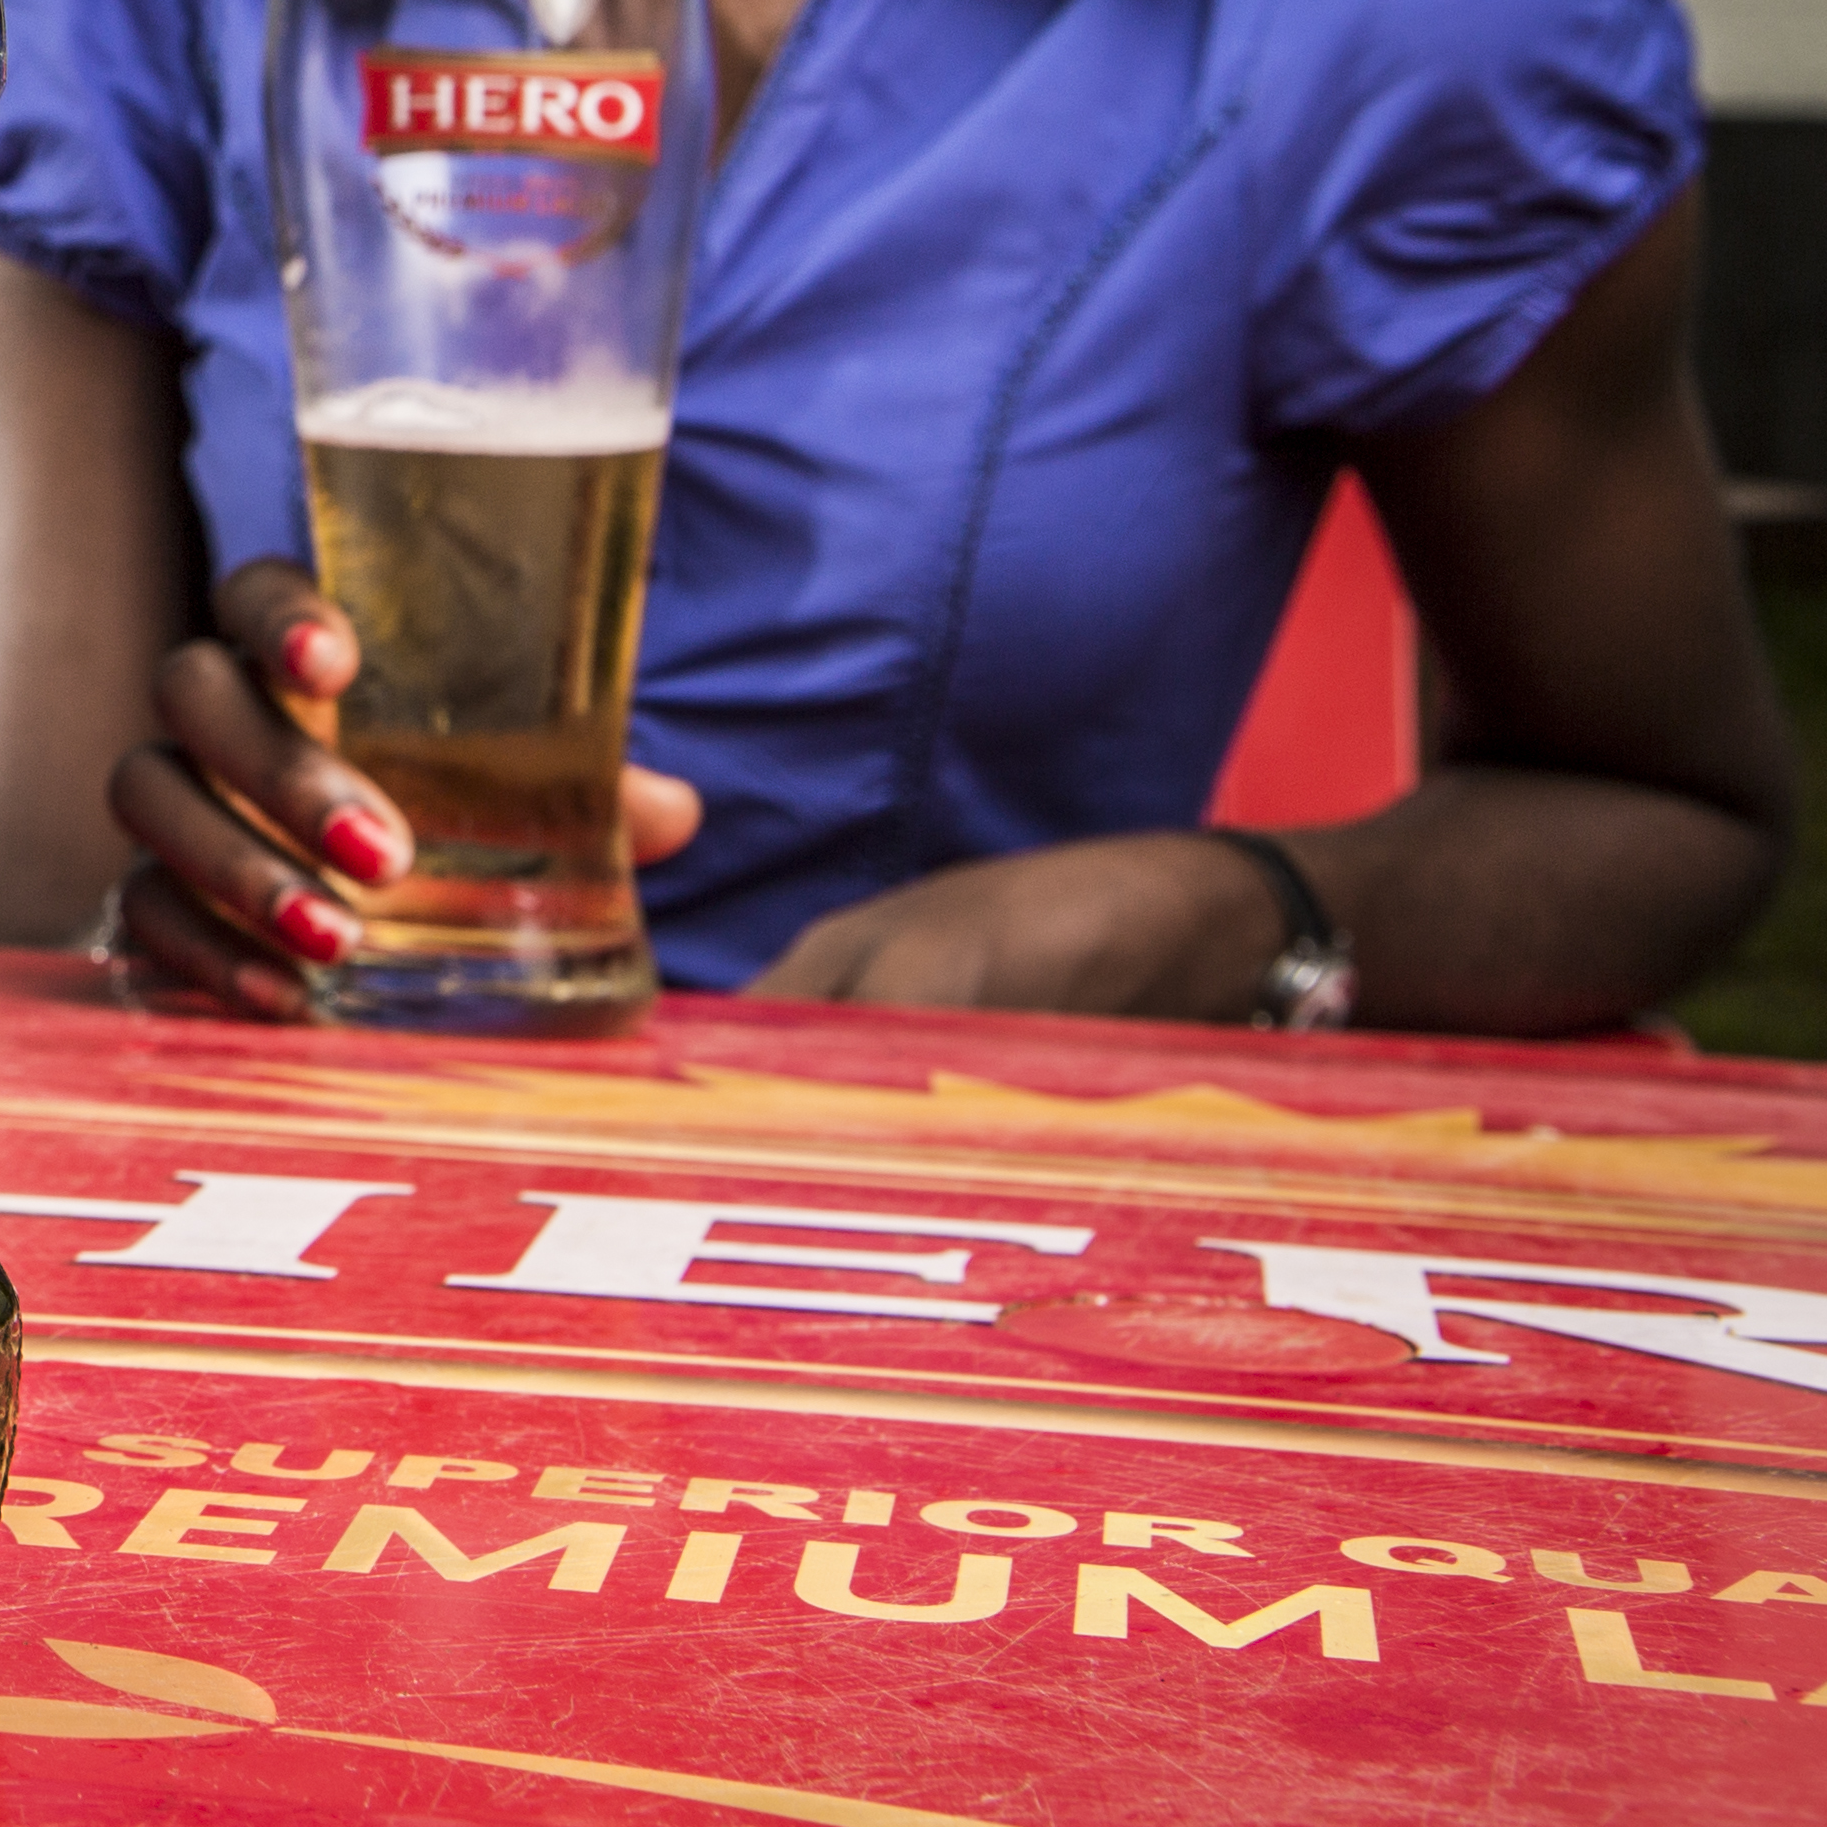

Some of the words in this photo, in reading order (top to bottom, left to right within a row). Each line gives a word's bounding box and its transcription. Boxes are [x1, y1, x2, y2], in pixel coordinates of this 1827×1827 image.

[391, 74, 643, 140] HERO
[82, 1434, 1256, 1558] SUPERIOR
[0, 1476, 1380, 1662] REMIUM
